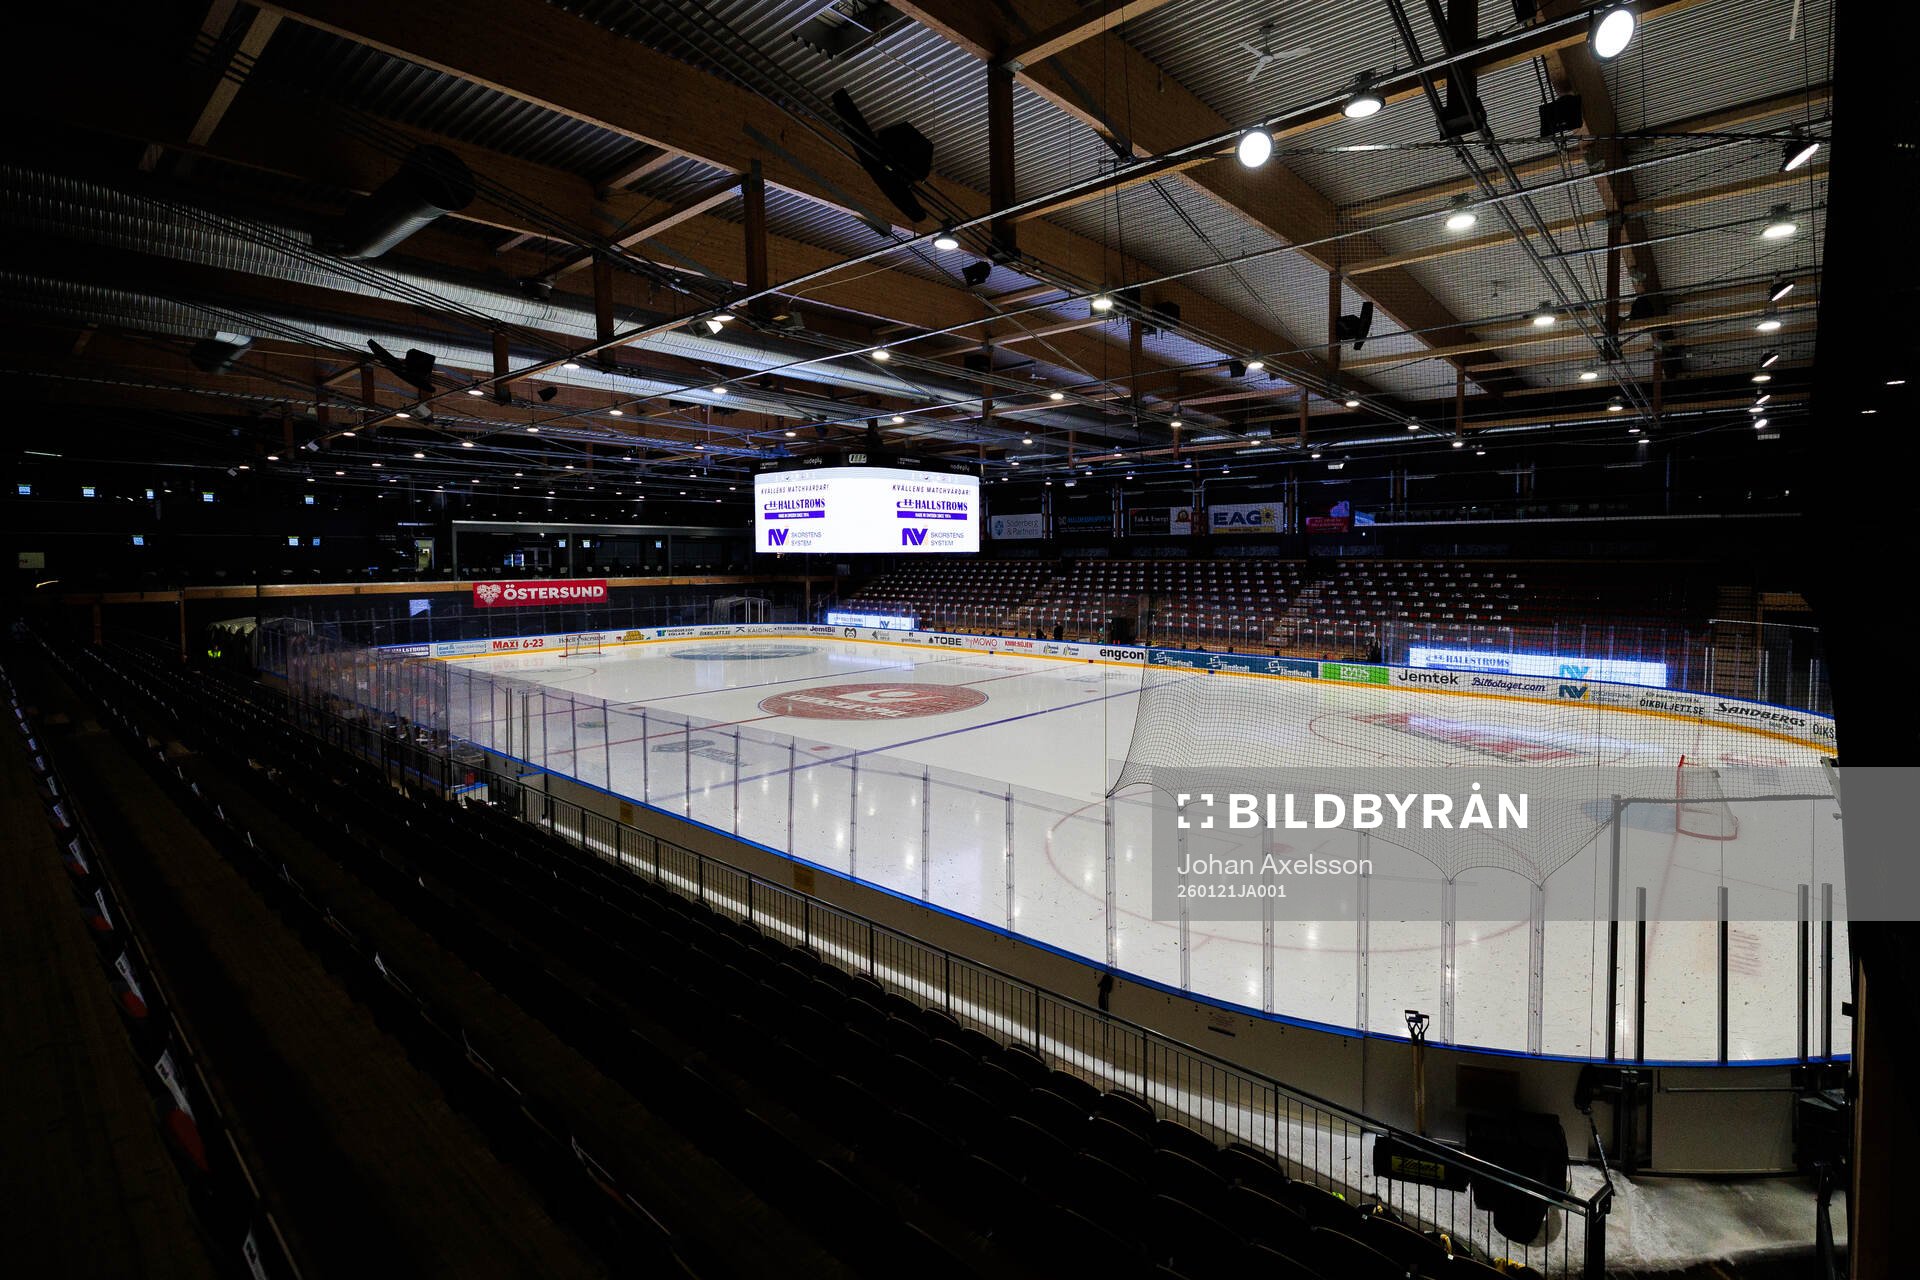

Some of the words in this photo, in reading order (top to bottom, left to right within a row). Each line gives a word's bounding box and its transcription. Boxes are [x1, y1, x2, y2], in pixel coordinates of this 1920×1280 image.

[1213, 510, 1262, 526] EAG
[503, 584, 604, 600] ÖSTERSUND
[522, 638, 544, 648] 6-23
[933, 636, 962, 646] TOBE
[1099, 647, 1144, 661] engcon
[1398, 668, 1459, 685] Jemtek
[1471, 677, 1546, 692] Bilbolaget.com
[1639, 697, 1705, 715] ÖIKBILJETT.SE
[1713, 702, 1806, 728] SANDBERGS
